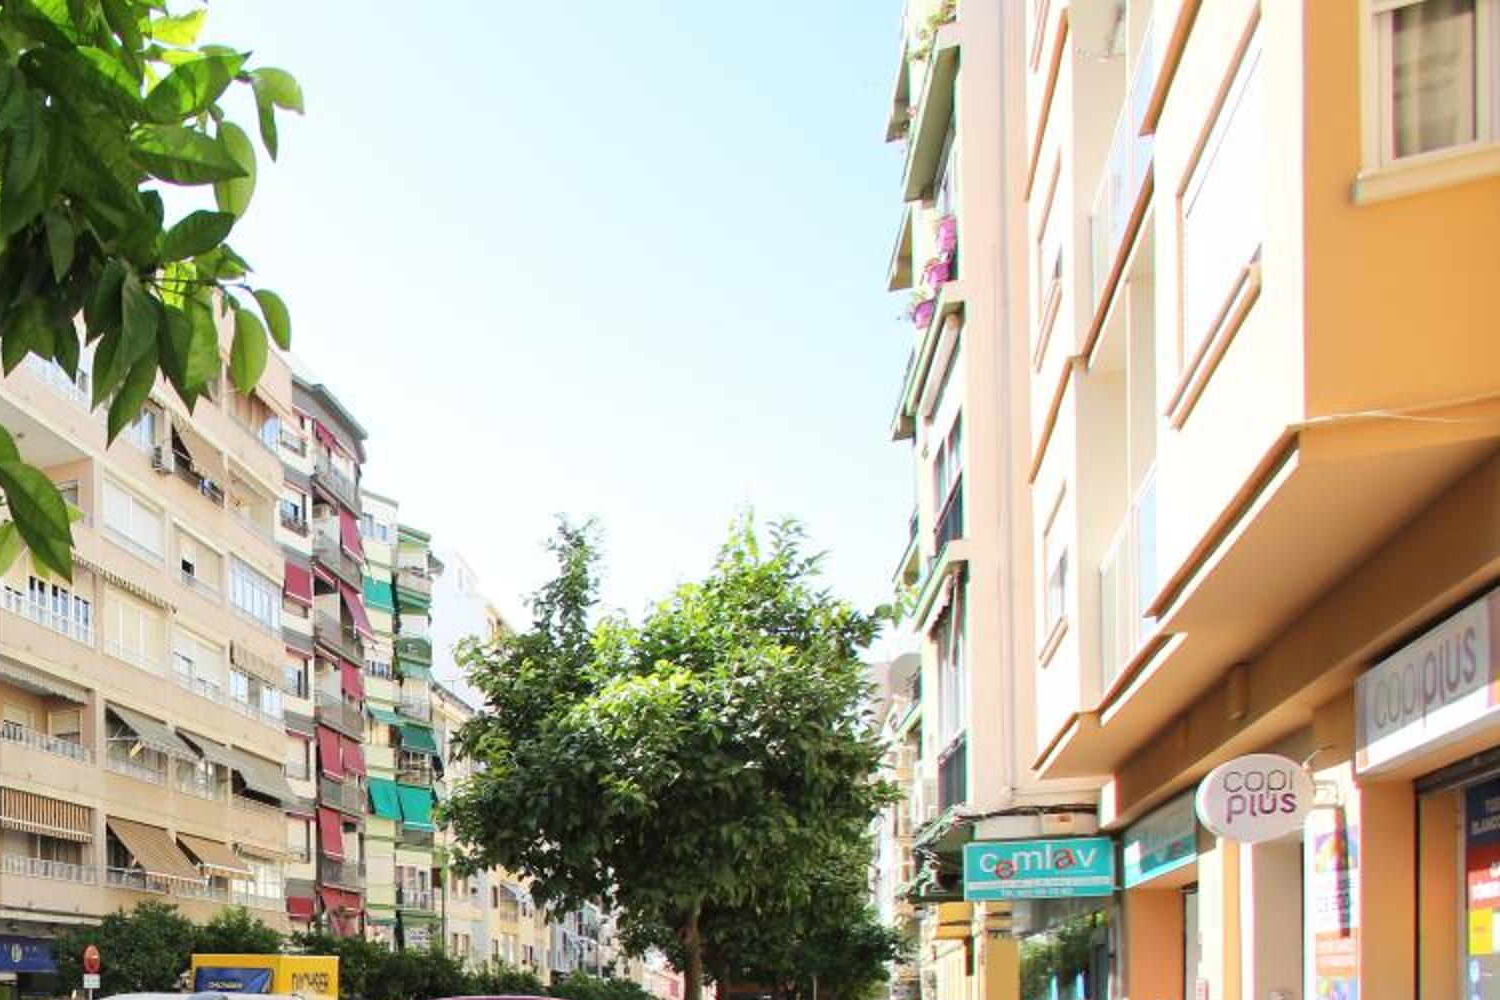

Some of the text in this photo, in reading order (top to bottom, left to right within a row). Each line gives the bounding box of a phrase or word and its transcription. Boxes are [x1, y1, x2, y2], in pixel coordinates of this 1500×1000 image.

[1223, 769, 1293, 793] cool
[1226, 793, 1297, 824] plus
[979, 844, 1097, 880] cemlav
